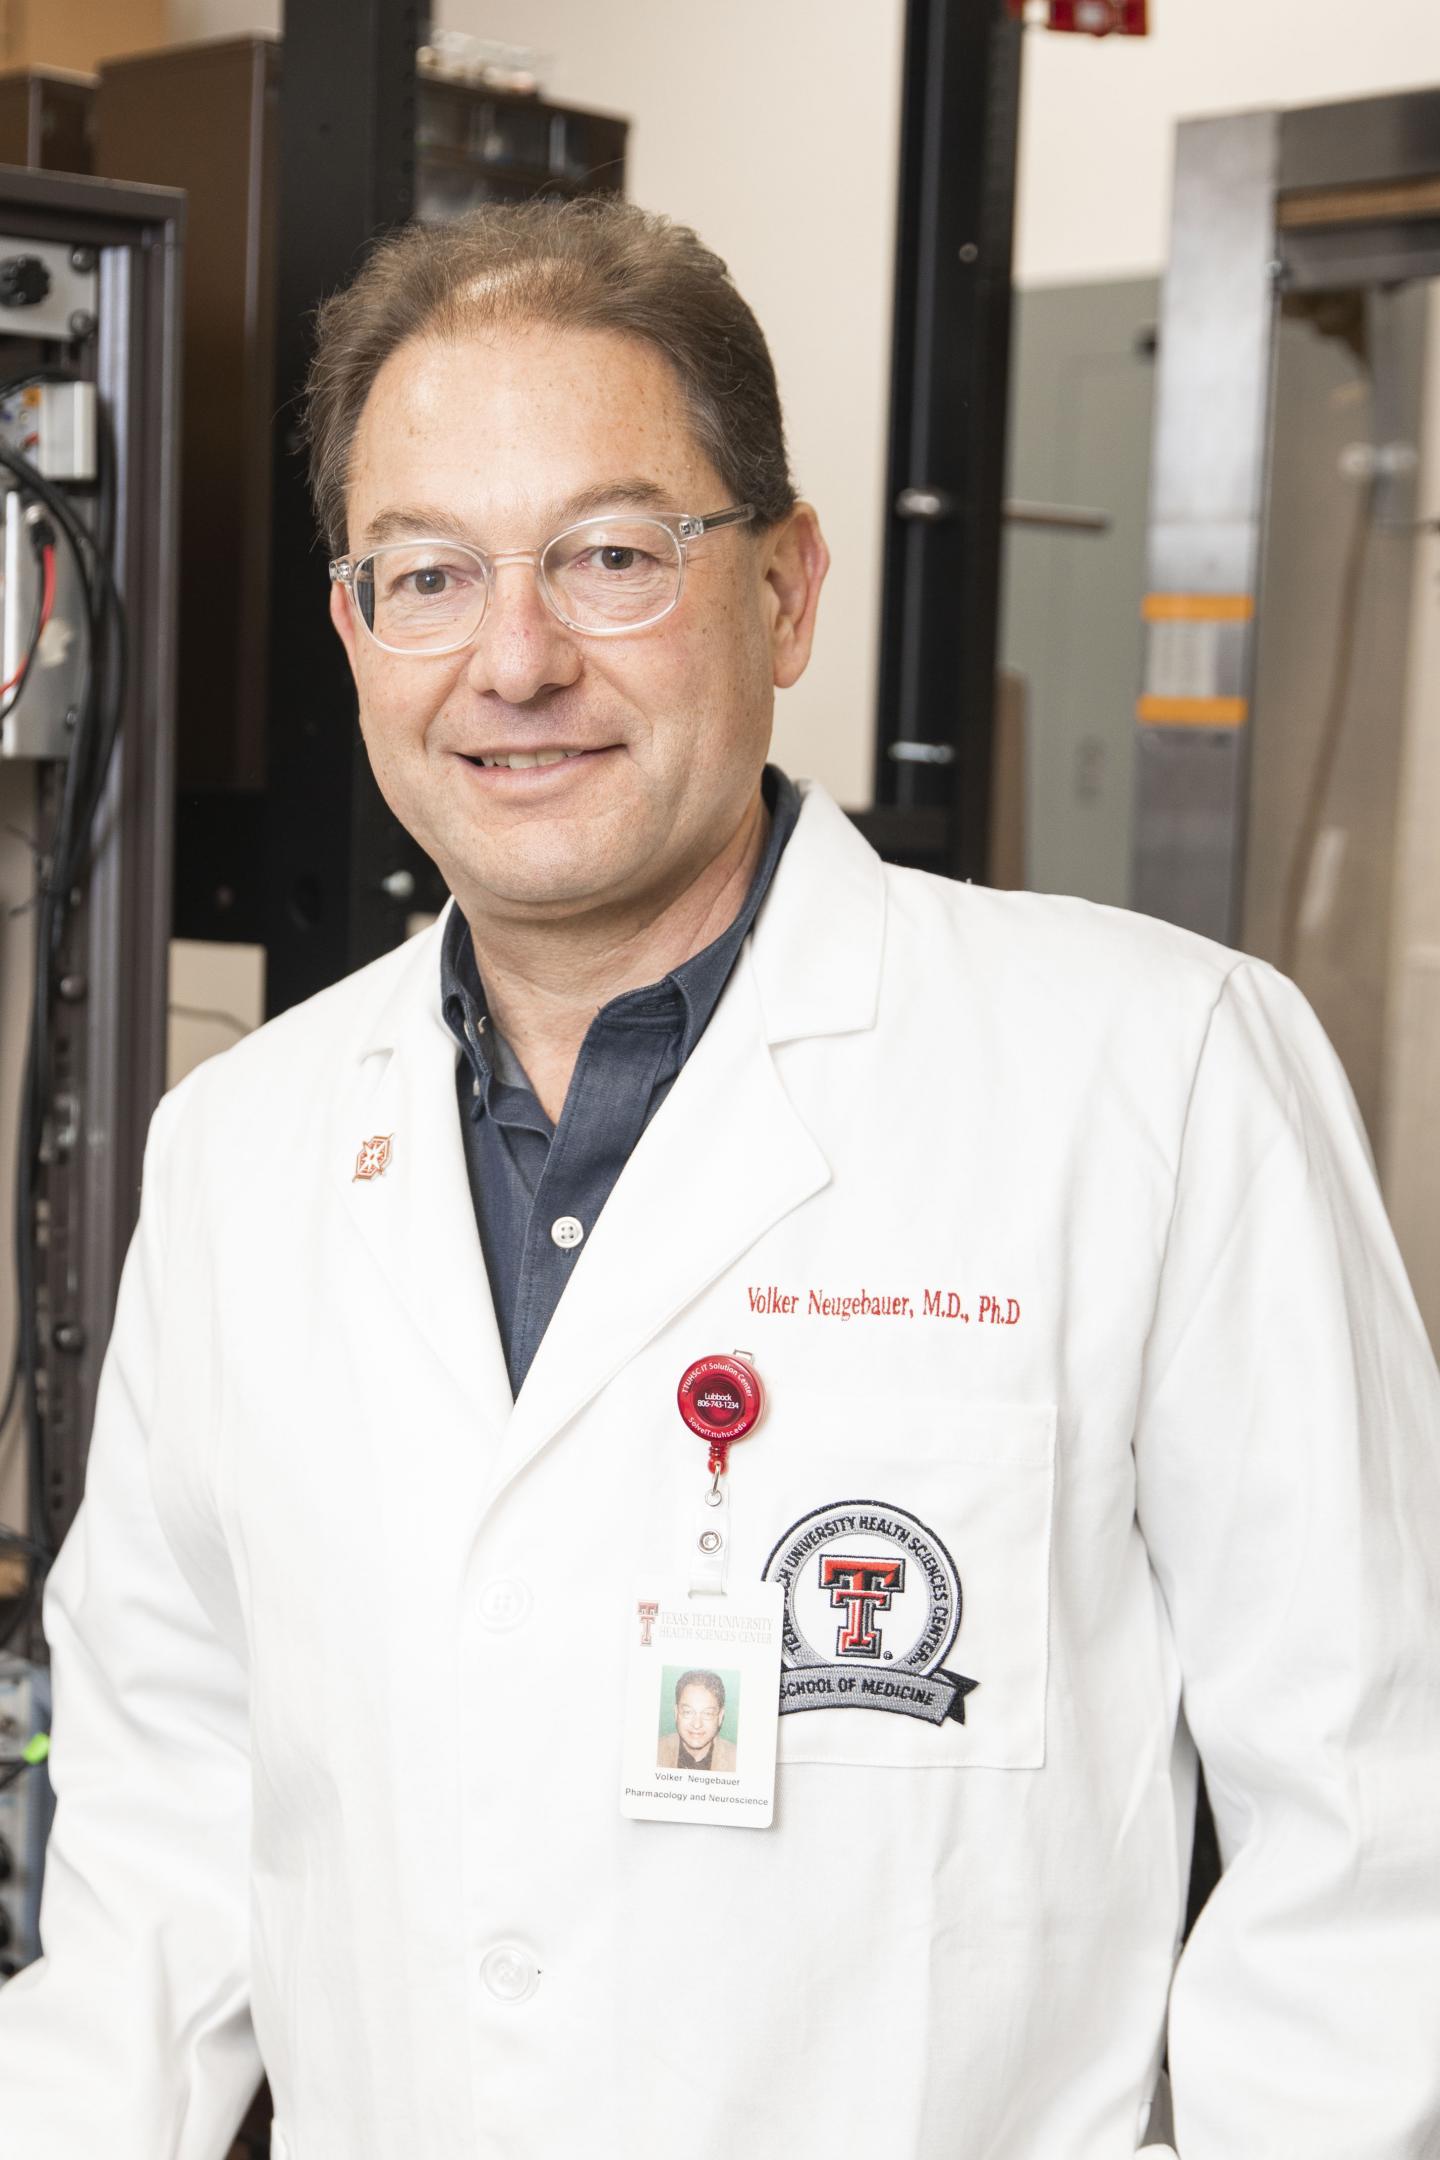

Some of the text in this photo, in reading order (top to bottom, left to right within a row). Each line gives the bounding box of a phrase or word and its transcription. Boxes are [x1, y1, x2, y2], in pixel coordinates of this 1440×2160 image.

[748, 1286, 1021, 1325] Volker Neugebauer, M.D., Ph.D
[682, 1362, 753, 1397] TTUHSC IT Solution Center
[697, 1399, 739, 1409] 806-743-1234
[704, 1392, 732, 1401] Lubbock
[784, 1516, 856, 1568] UNIVERSITY
[859, 1516, 910, 1544] HEALTH
[908, 1538, 949, 1601] SCIENCES
[718, 1615, 774, 1631] UNIVERSITY
[919, 1606, 949, 1661] CENTER
[837, 1678, 857, 1692] OF
[861, 1680, 935, 1705] MEDICINE
[655, 1772, 740, 1786] Volker Neugebauer
[625, 1787, 769, 1806] Pharmacology and Neuroscience
